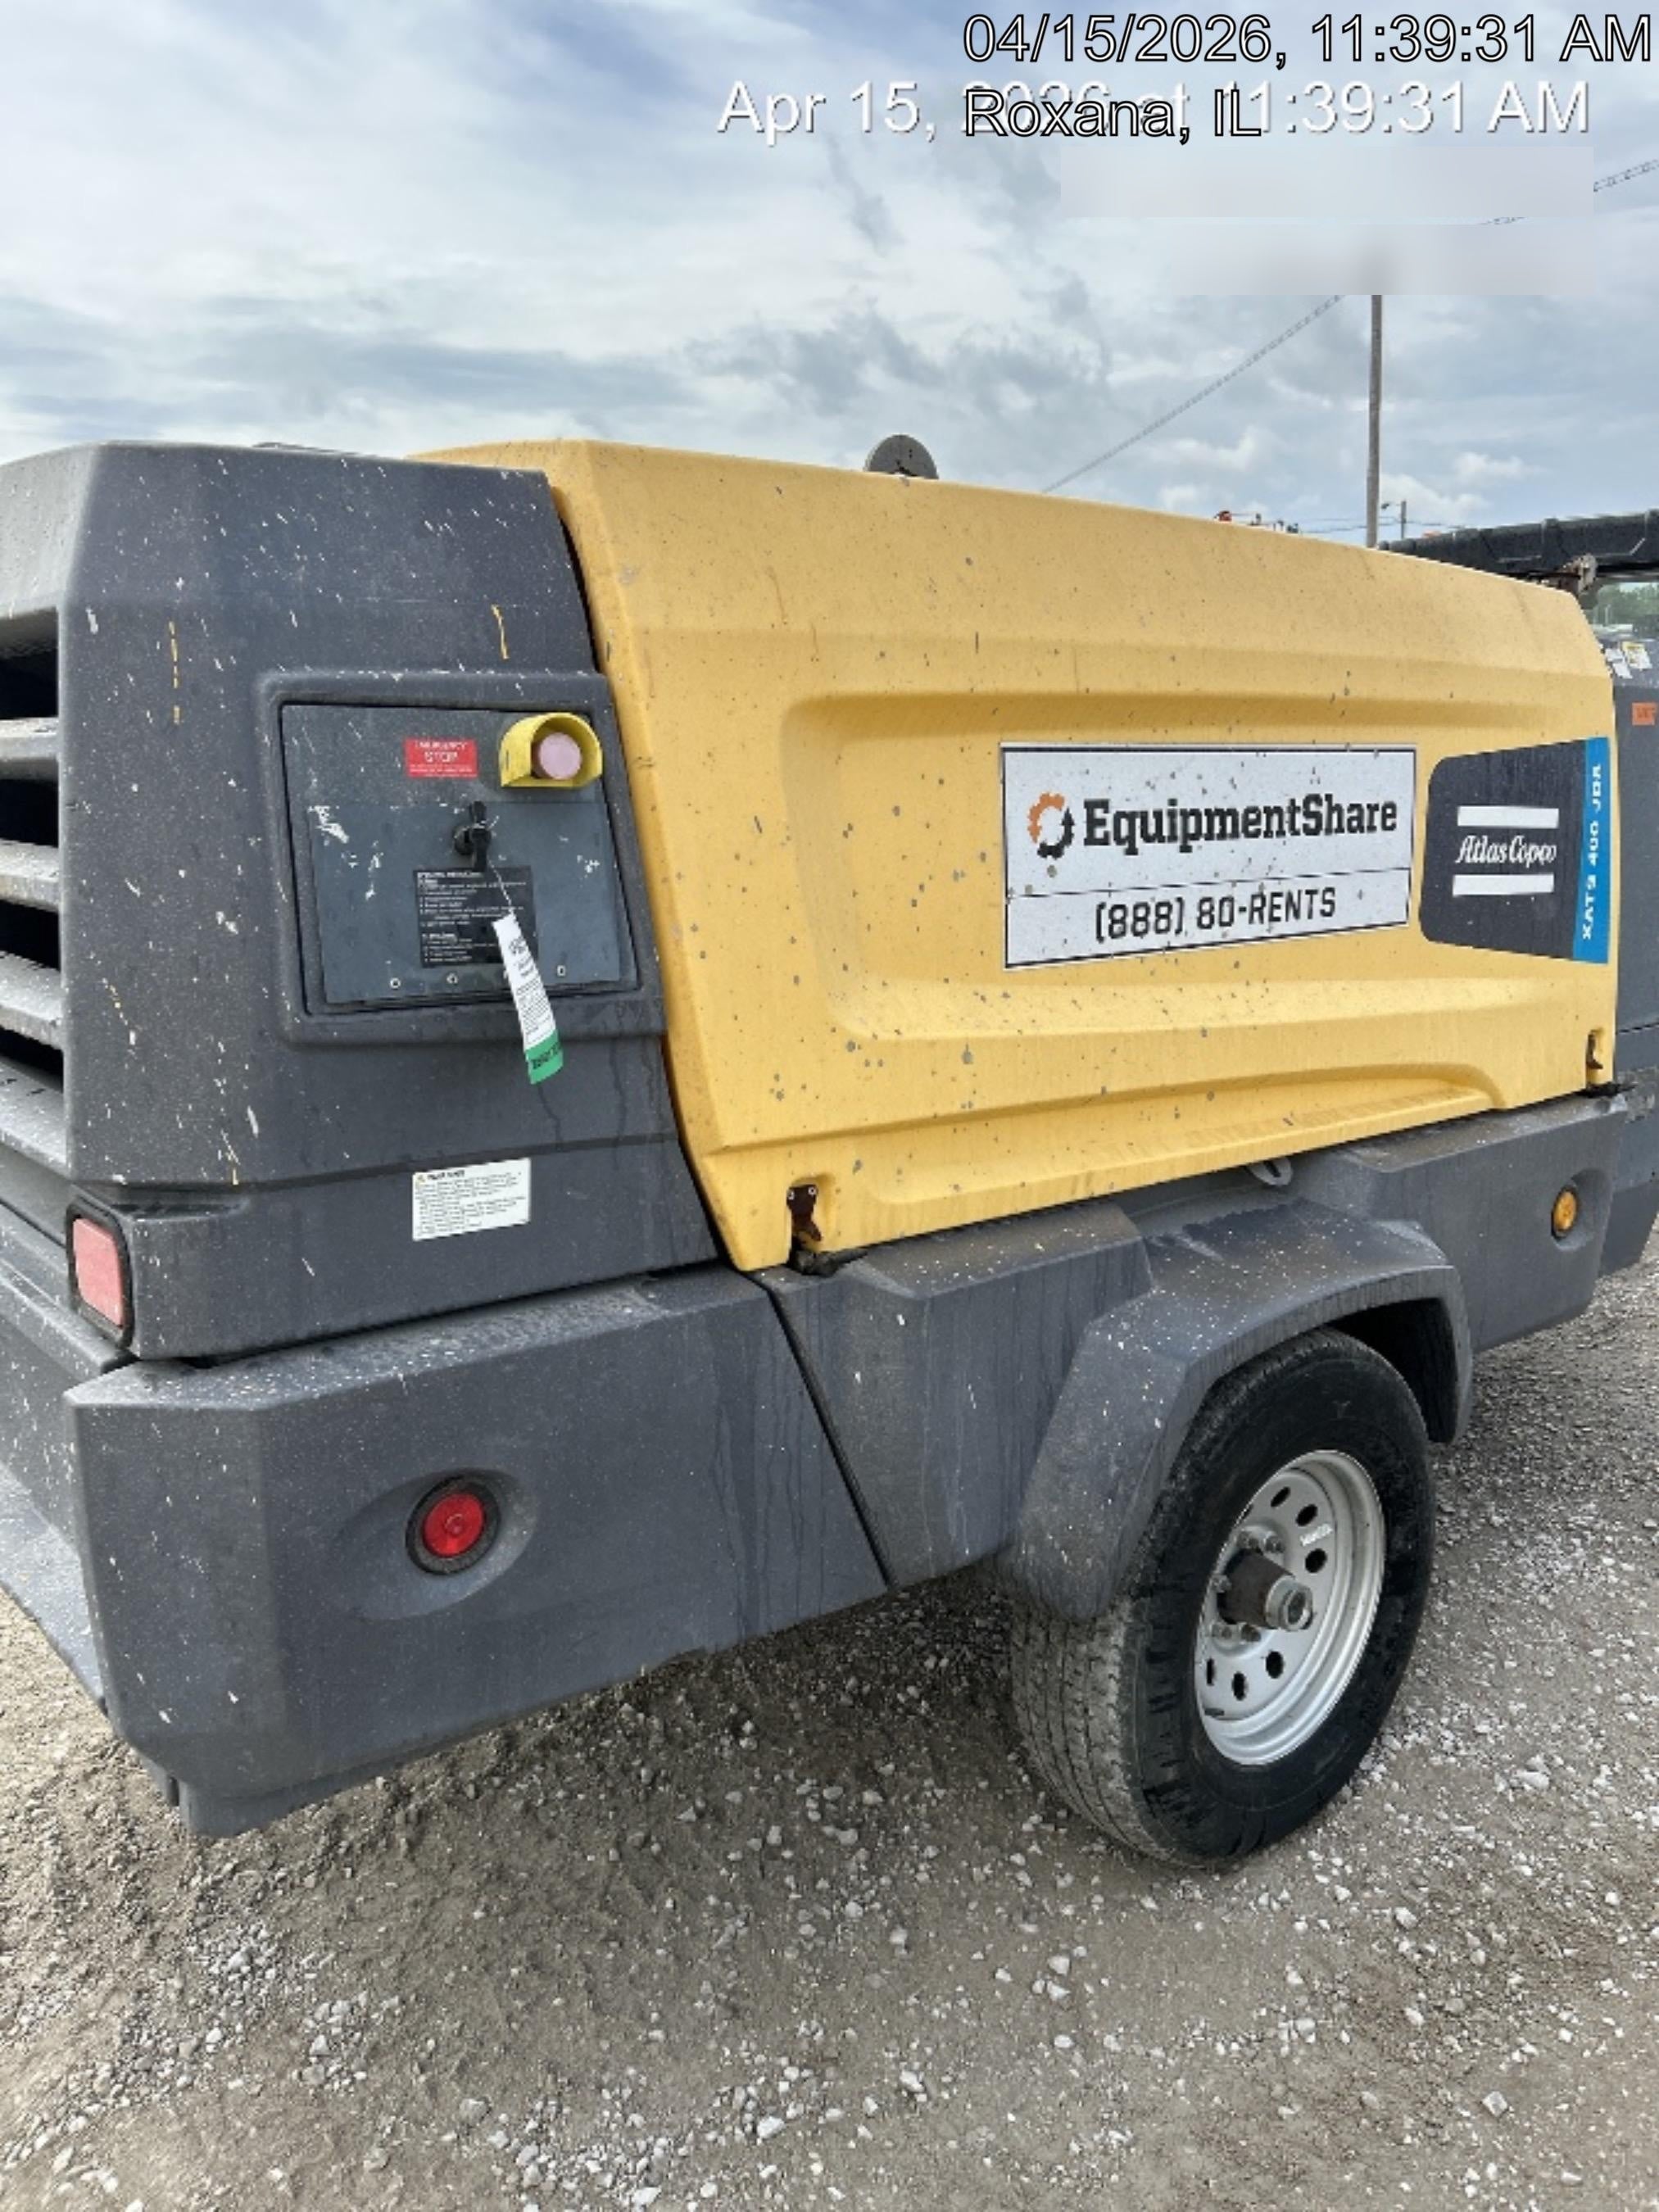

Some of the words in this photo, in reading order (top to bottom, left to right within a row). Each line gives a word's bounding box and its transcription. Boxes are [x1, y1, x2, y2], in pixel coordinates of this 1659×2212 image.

[1083, 793, 1398, 856] EquipmentShare
[1095, 895, 1185, 943] (888)
[1196, 886, 1337, 931] 80-RENTS
